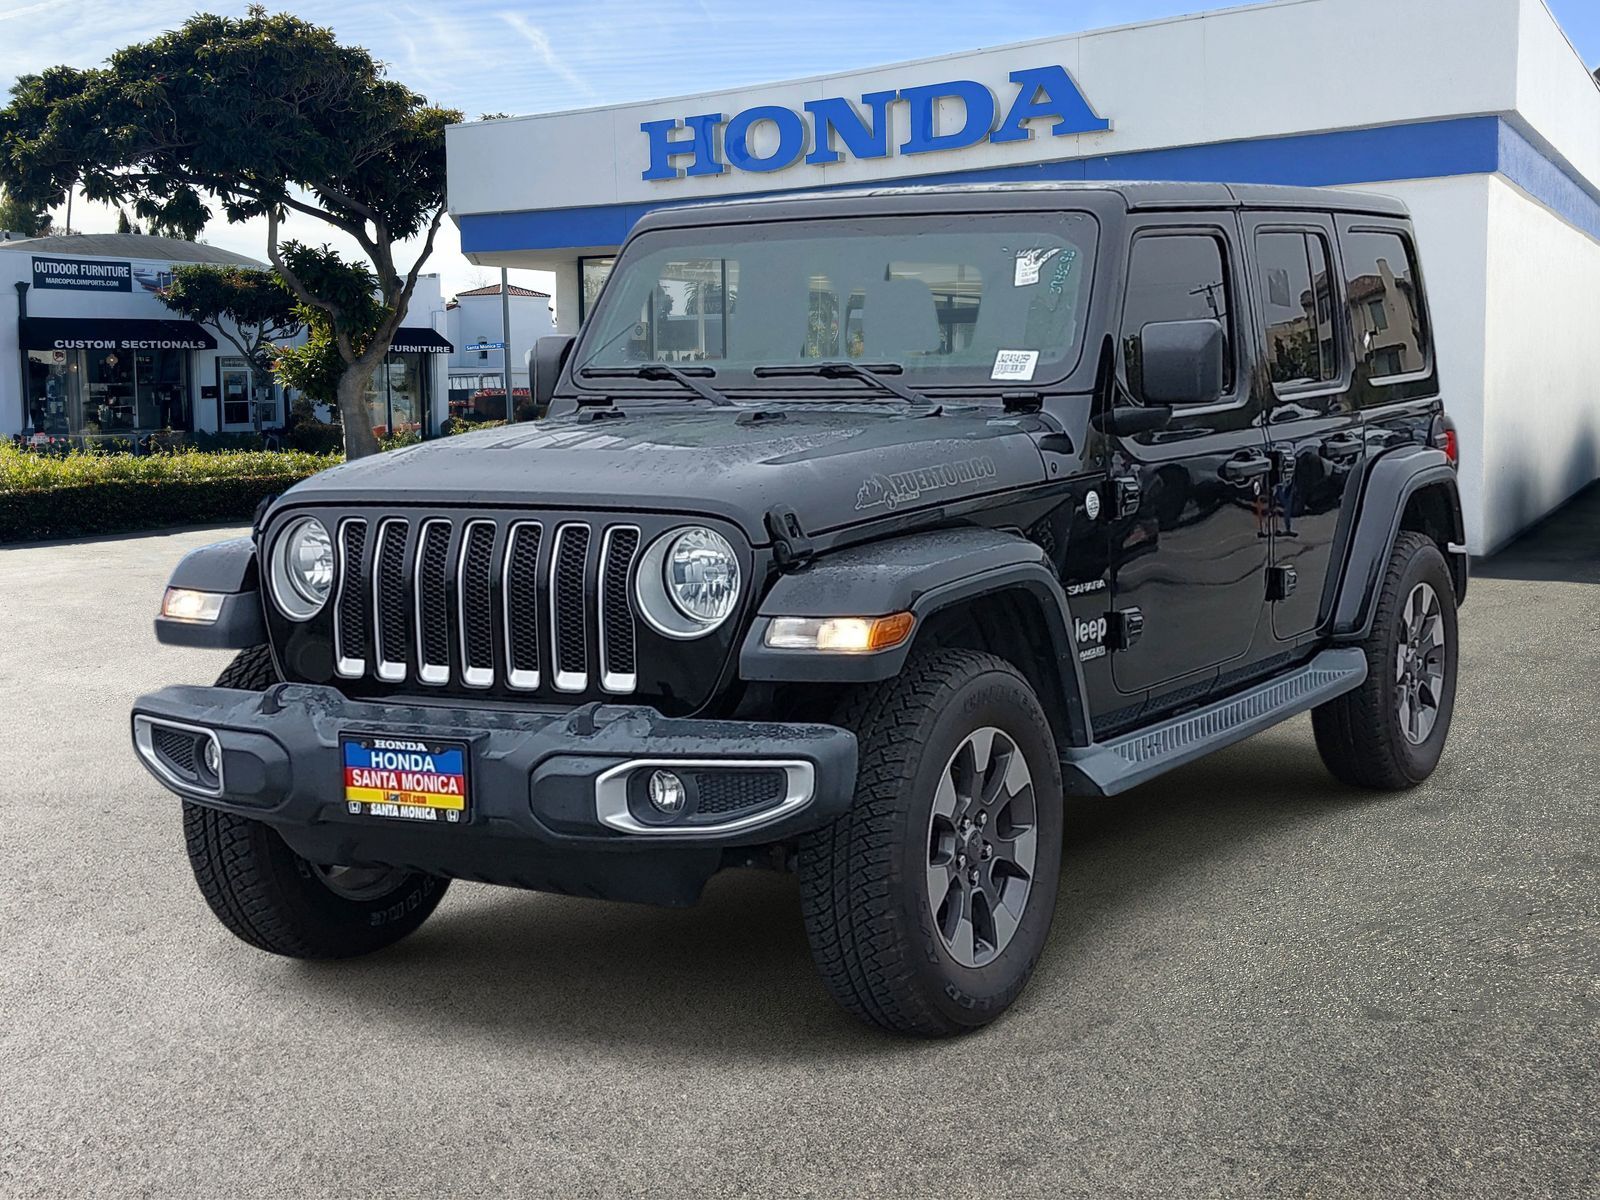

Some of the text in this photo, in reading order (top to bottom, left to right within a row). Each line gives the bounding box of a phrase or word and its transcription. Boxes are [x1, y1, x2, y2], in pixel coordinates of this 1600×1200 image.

[641, 64, 1110, 182] HONDA
[34, 261, 130, 278] OUTDOOR FURNITURE
[45, 277, 119, 287] MARCOPOLOIMPORTS.COM
[54, 339, 206, 349] CUSTOM SECTIONALS
[388, 345, 450, 353] FURNITURE
[889, 455, 997, 496] PUERTO RICO
[1067, 579, 1106, 595] SAHARA
[1075, 617, 1107, 643] Jeep
[374, 740, 427, 751] HONDA
[371, 752, 435, 772] HONDA
[352, 769, 458, 794] SANTA MONICA
[370, 803, 437, 820] SANTA MONICA
